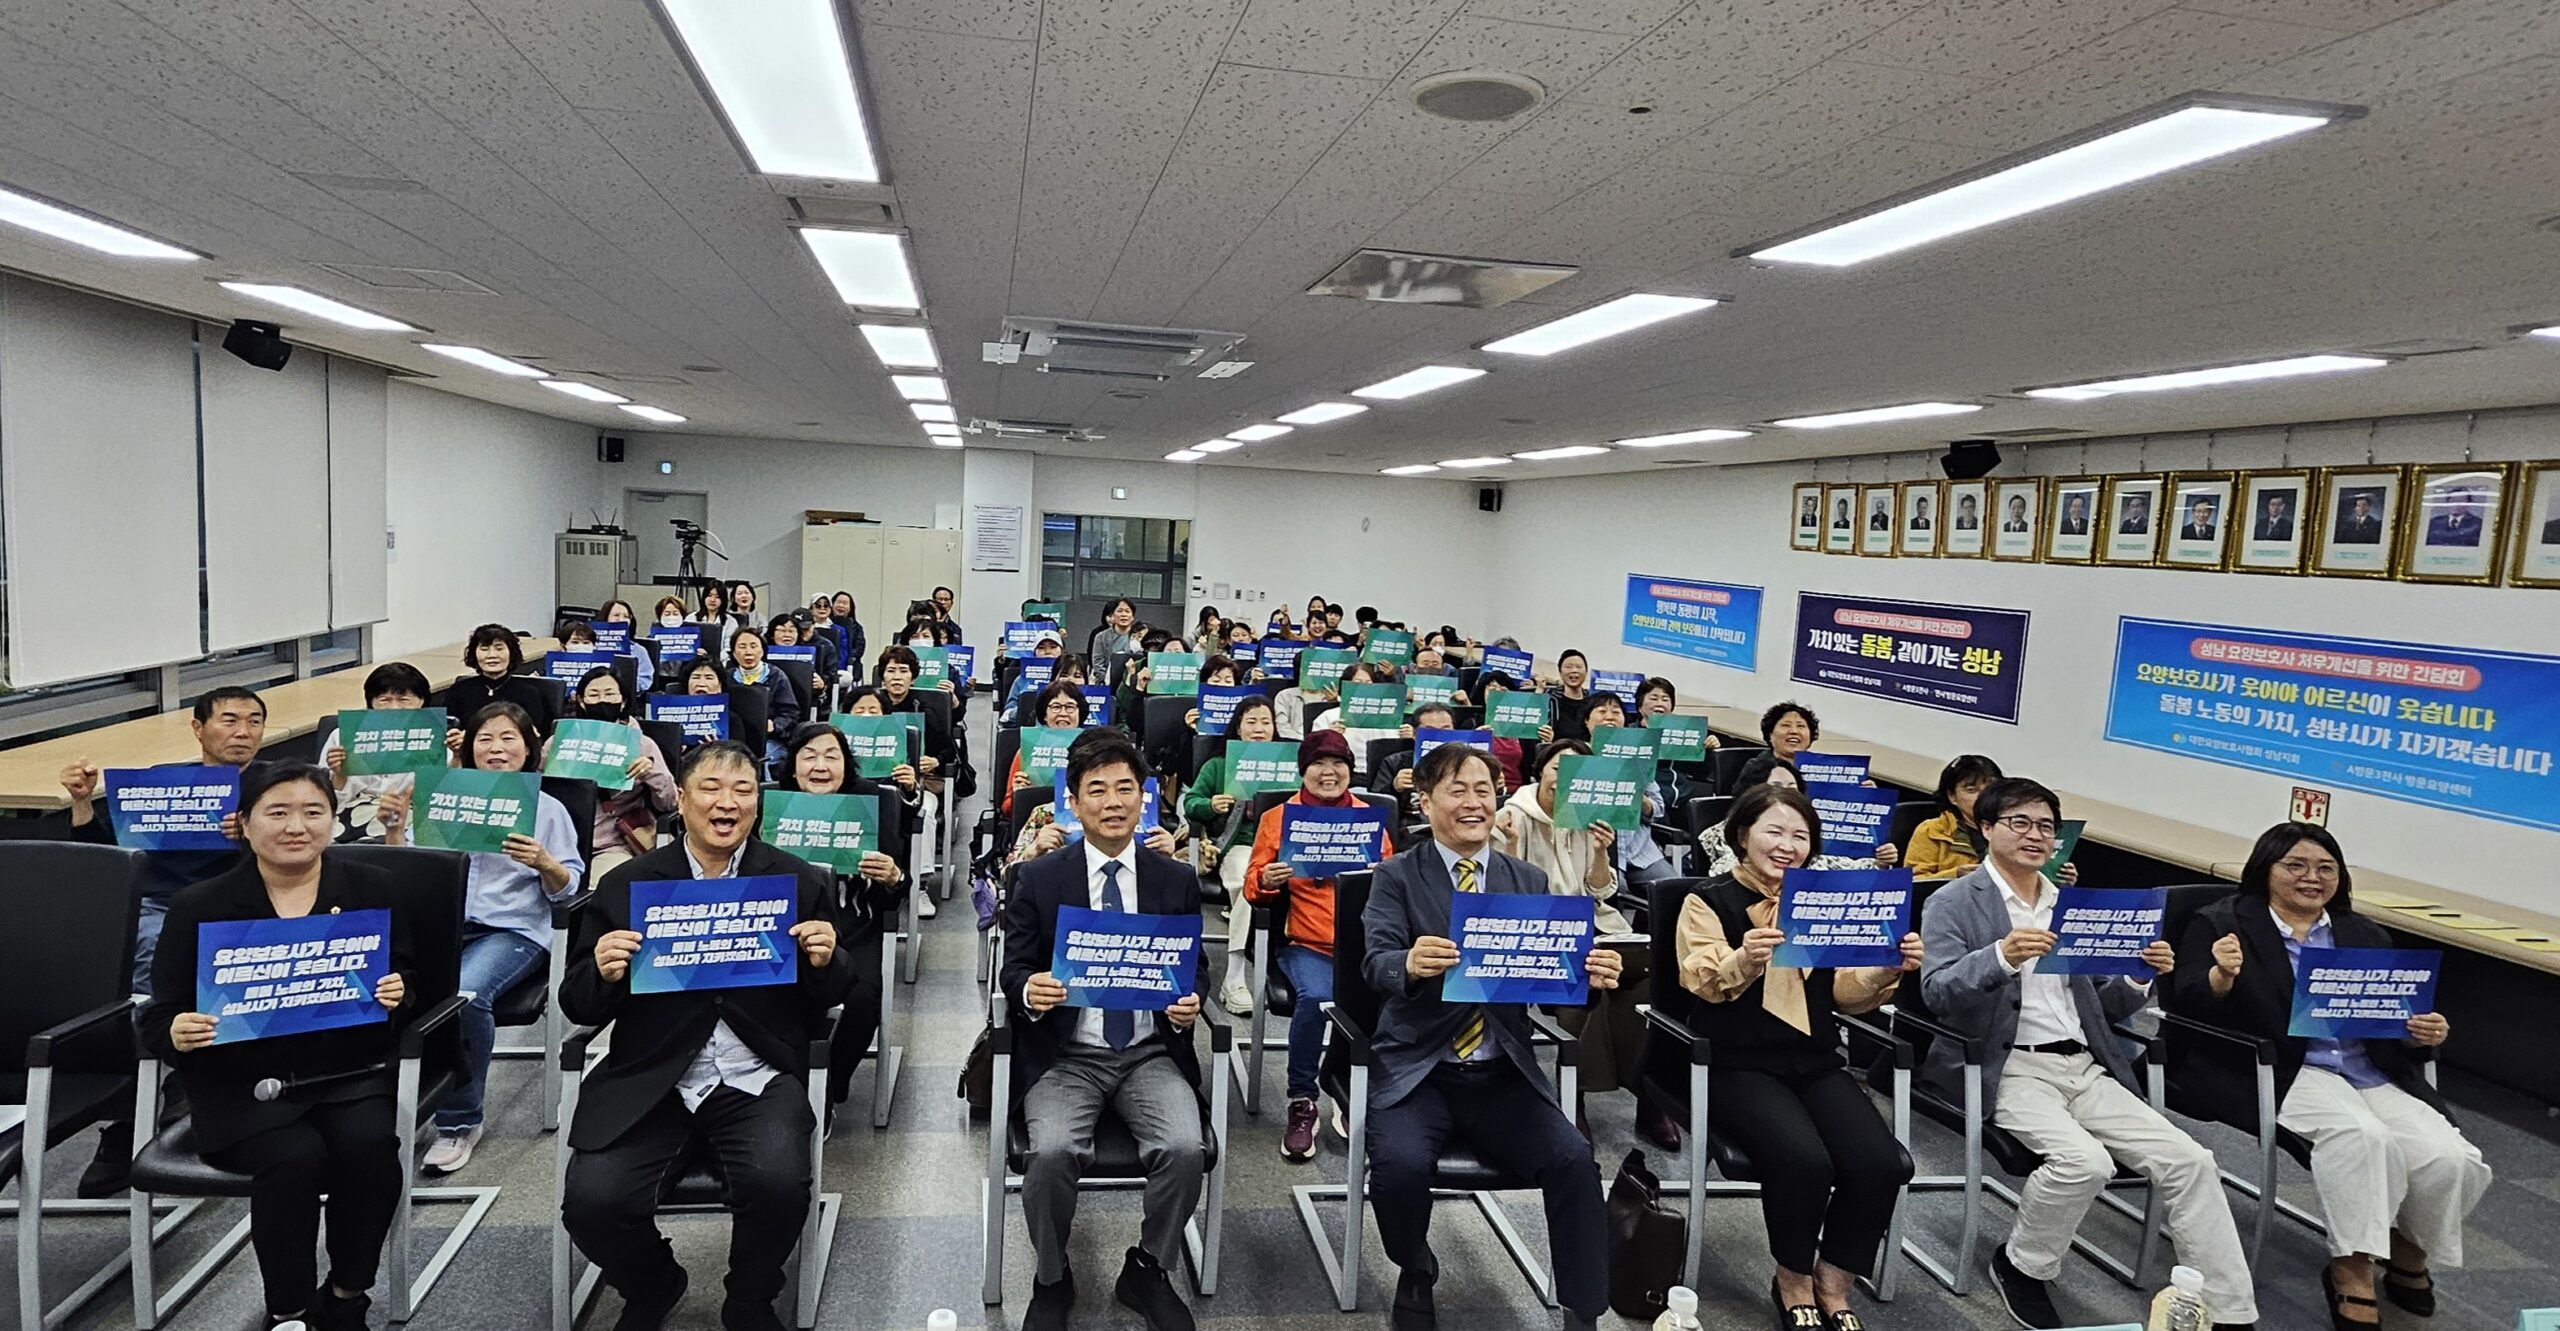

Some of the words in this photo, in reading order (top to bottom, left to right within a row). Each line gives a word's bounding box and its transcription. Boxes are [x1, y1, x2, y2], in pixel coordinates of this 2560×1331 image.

[1962, 646, 2002, 677] 성남
[2200, 641, 2224, 658] 성남
[2226, 644, 2295, 666] 요양보호사
[2298, 652, 2373, 676] 처우개선을
[2376, 660, 2409, 680] 위한
[2412, 664, 2466, 686] 간담회
[2136, 663, 2236, 694] 요양보호사가
[2241, 676, 2299, 704] 웃어야
[2303, 684, 2392, 717] 어르신이
[2396, 698, 2496, 732] 웃습니다
[2160, 693, 2192, 715] 돌봄
[2197, 700, 2250, 726] 노동의
[2254, 708, 2298, 737] 가치,
[2305, 717, 2392, 751] 성남시가
[2399, 728, 2553, 777] 지키겠습니다
[1568, 778, 1593, 792] 가치
[429, 792, 458, 807] 가치
[460, 796, 488, 810] 있는
[776, 818, 803, 832] 가치
[805, 820, 832, 833] 있는
[1870, 891, 1906, 905] 웃어야
[644, 902, 740, 922] 요양보호사가
[742, 900, 789, 916] 웃어야
[1844, 906, 1898, 920] 웃습니다.
[646, 920, 710, 938] 어르신이
[712, 916, 777, 935] 웃습니다.
[1463, 917, 1547, 934] 요양보호사가
[1548, 920, 1588, 935] 웃어야
[214, 940, 324, 966] 요양보호사가
[327, 934, 380, 955] 웃어야
[733, 936, 760, 950] 가치,
[1066, 930, 1150, 950] 요양보호사가
[1151, 936, 1193, 951] 웃어야
[1463, 934, 1519, 950] 어르신이
[1520, 935, 1578, 952] 웃습니다.
[1066, 946, 1122, 962] 어르신이
[1123, 948, 1181, 966] 웃습니다.
[214, 963, 289, 984] 어르신이
[292, 953, 368, 978] 웃습니다.
[316, 976, 347, 992] 가치,
